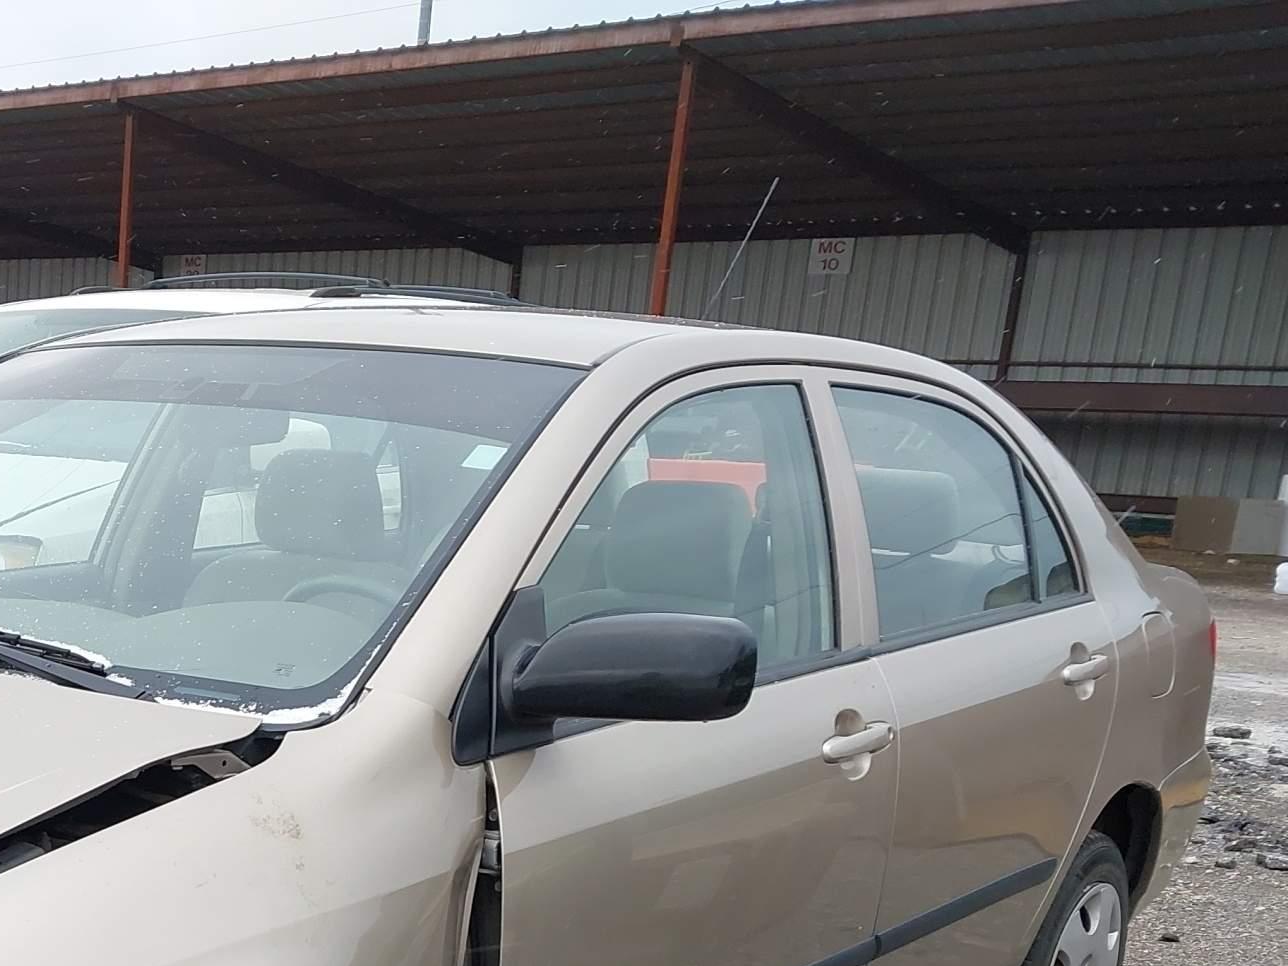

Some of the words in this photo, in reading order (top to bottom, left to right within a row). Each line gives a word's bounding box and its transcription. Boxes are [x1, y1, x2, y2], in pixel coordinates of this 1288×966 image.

[818, 240, 847, 255] MC
[185, 256, 201, 267] MC
[817, 258, 839, 271] 10
